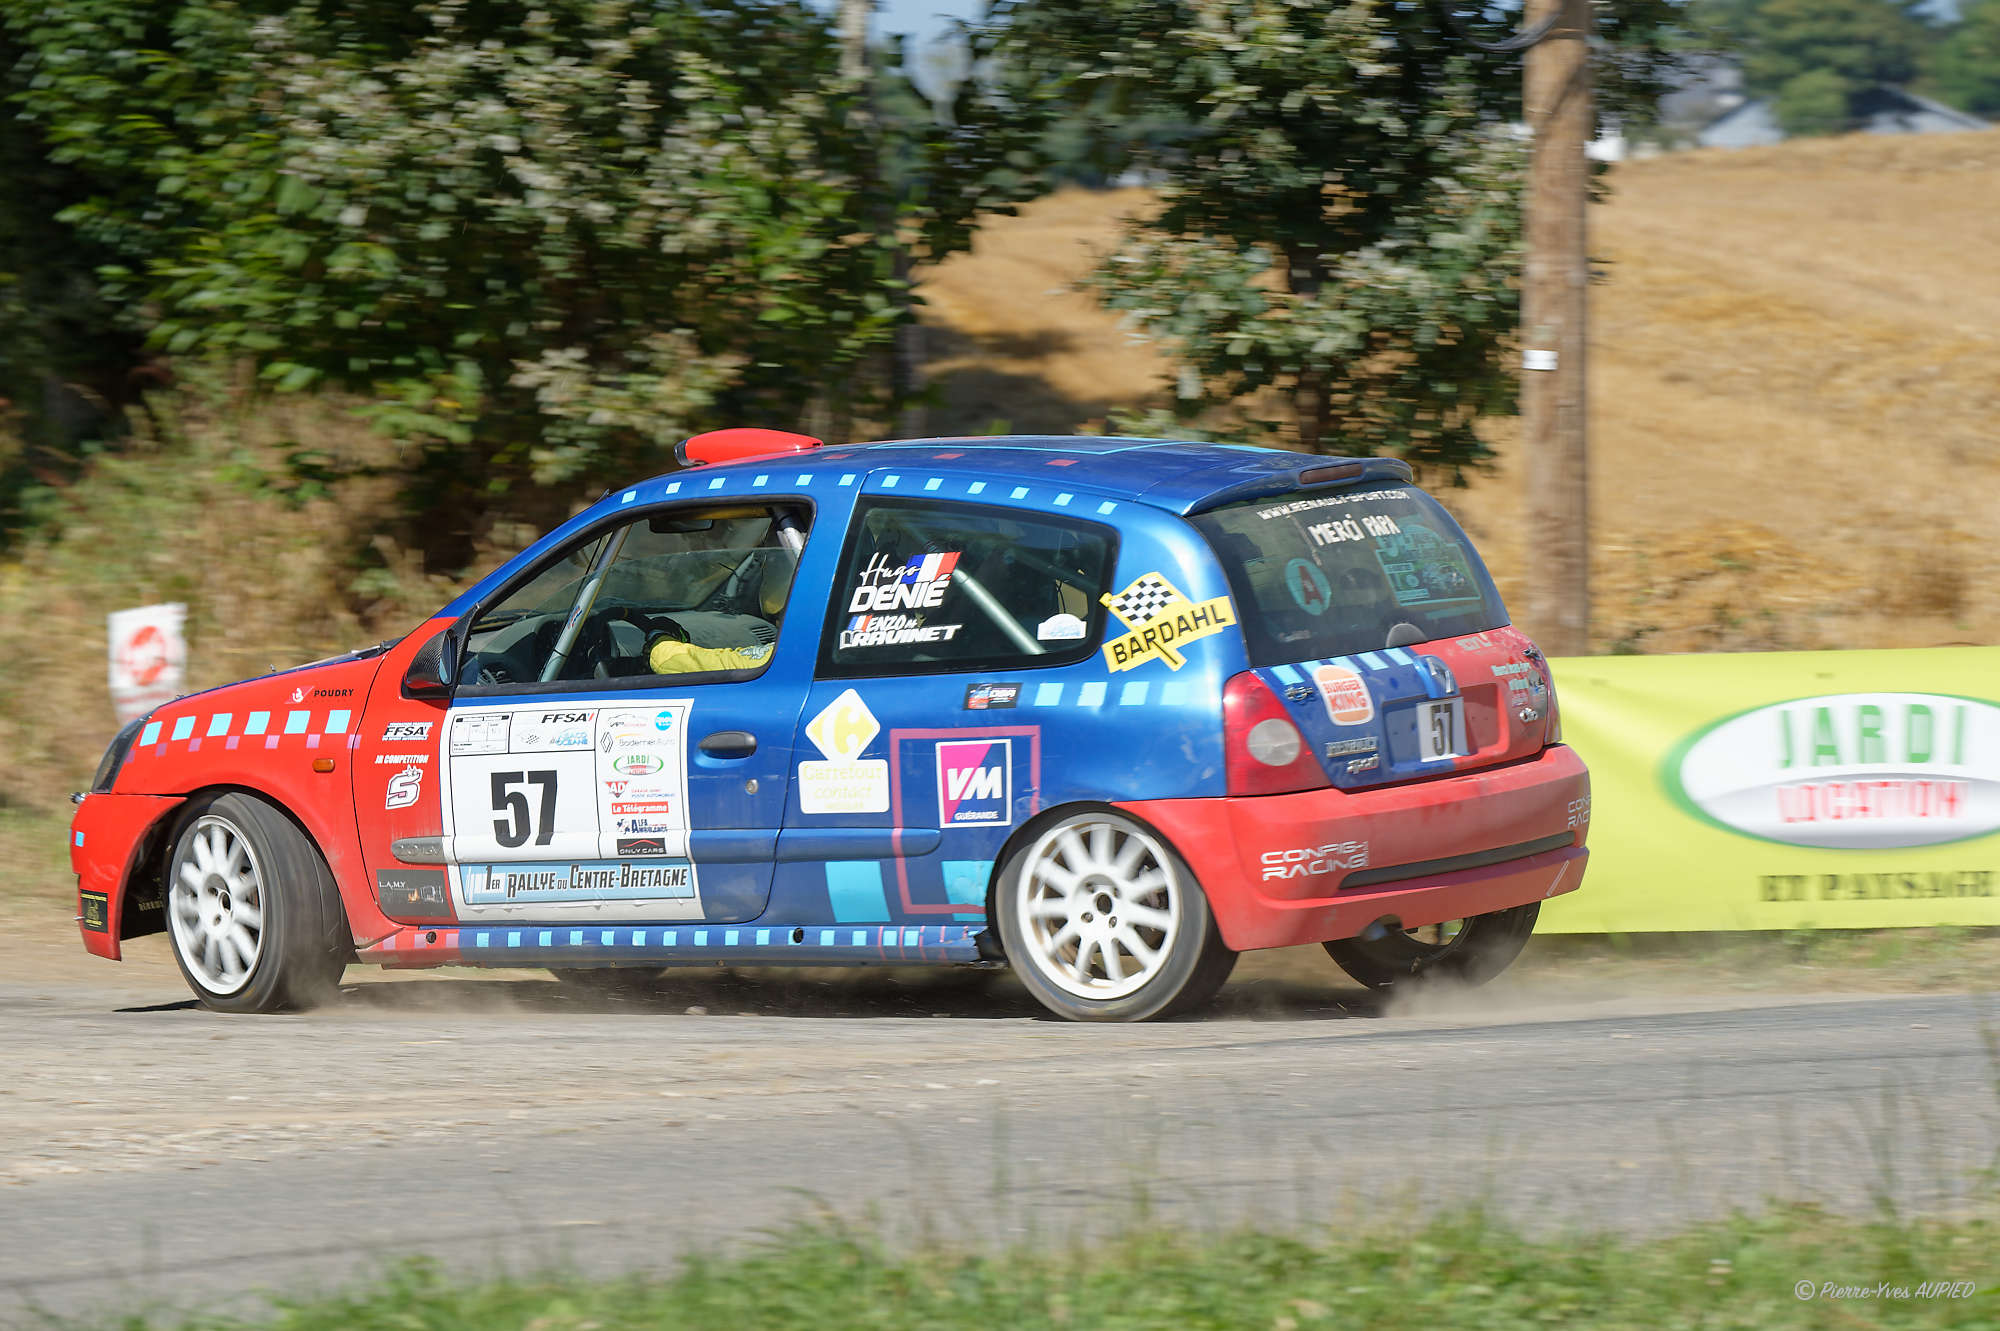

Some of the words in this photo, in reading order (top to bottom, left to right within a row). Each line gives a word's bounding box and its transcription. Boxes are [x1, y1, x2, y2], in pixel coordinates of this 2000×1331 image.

[1307, 513, 1365, 546] MERCI
[1361, 514, 1401, 537] PAPA
[860, 552, 921, 593] Hugo
[848, 573, 951, 612] DENIÉ
[868, 614, 907, 632] ENZO
[1112, 604, 1227, 664] BARDAHL
[314, 689, 354, 697] POUDRY
[1322, 680, 1361, 694] BURGER
[1328, 692, 1367, 713] KING
[541, 713, 588, 724] FFSA
[384, 726, 426, 736] FFSA
[1431, 703, 1454, 756] 57
[1777, 704, 1967, 769] JARDI
[384, 754, 429, 764] COMPETITION
[627, 754, 650, 764] JARDI
[802, 763, 882, 780] Carrefour
[610, 782, 625, 793] AD
[947, 767, 1003, 800] VM
[491, 770, 558, 848] 57
[612, 805, 622, 813] Le
[623, 803, 668, 813] Télégramme
[1777, 780, 1968, 823] LOCATION
[954, 810, 999, 820] GUÉRANDE
[641, 847, 665, 855] CARS
[1262, 854, 1368, 881] RACING
[507, 872, 556, 898] RALLYE
[569, 864, 688, 889] CENTRE-BRETAGNE
[1759, 874, 1808, 902] ET
